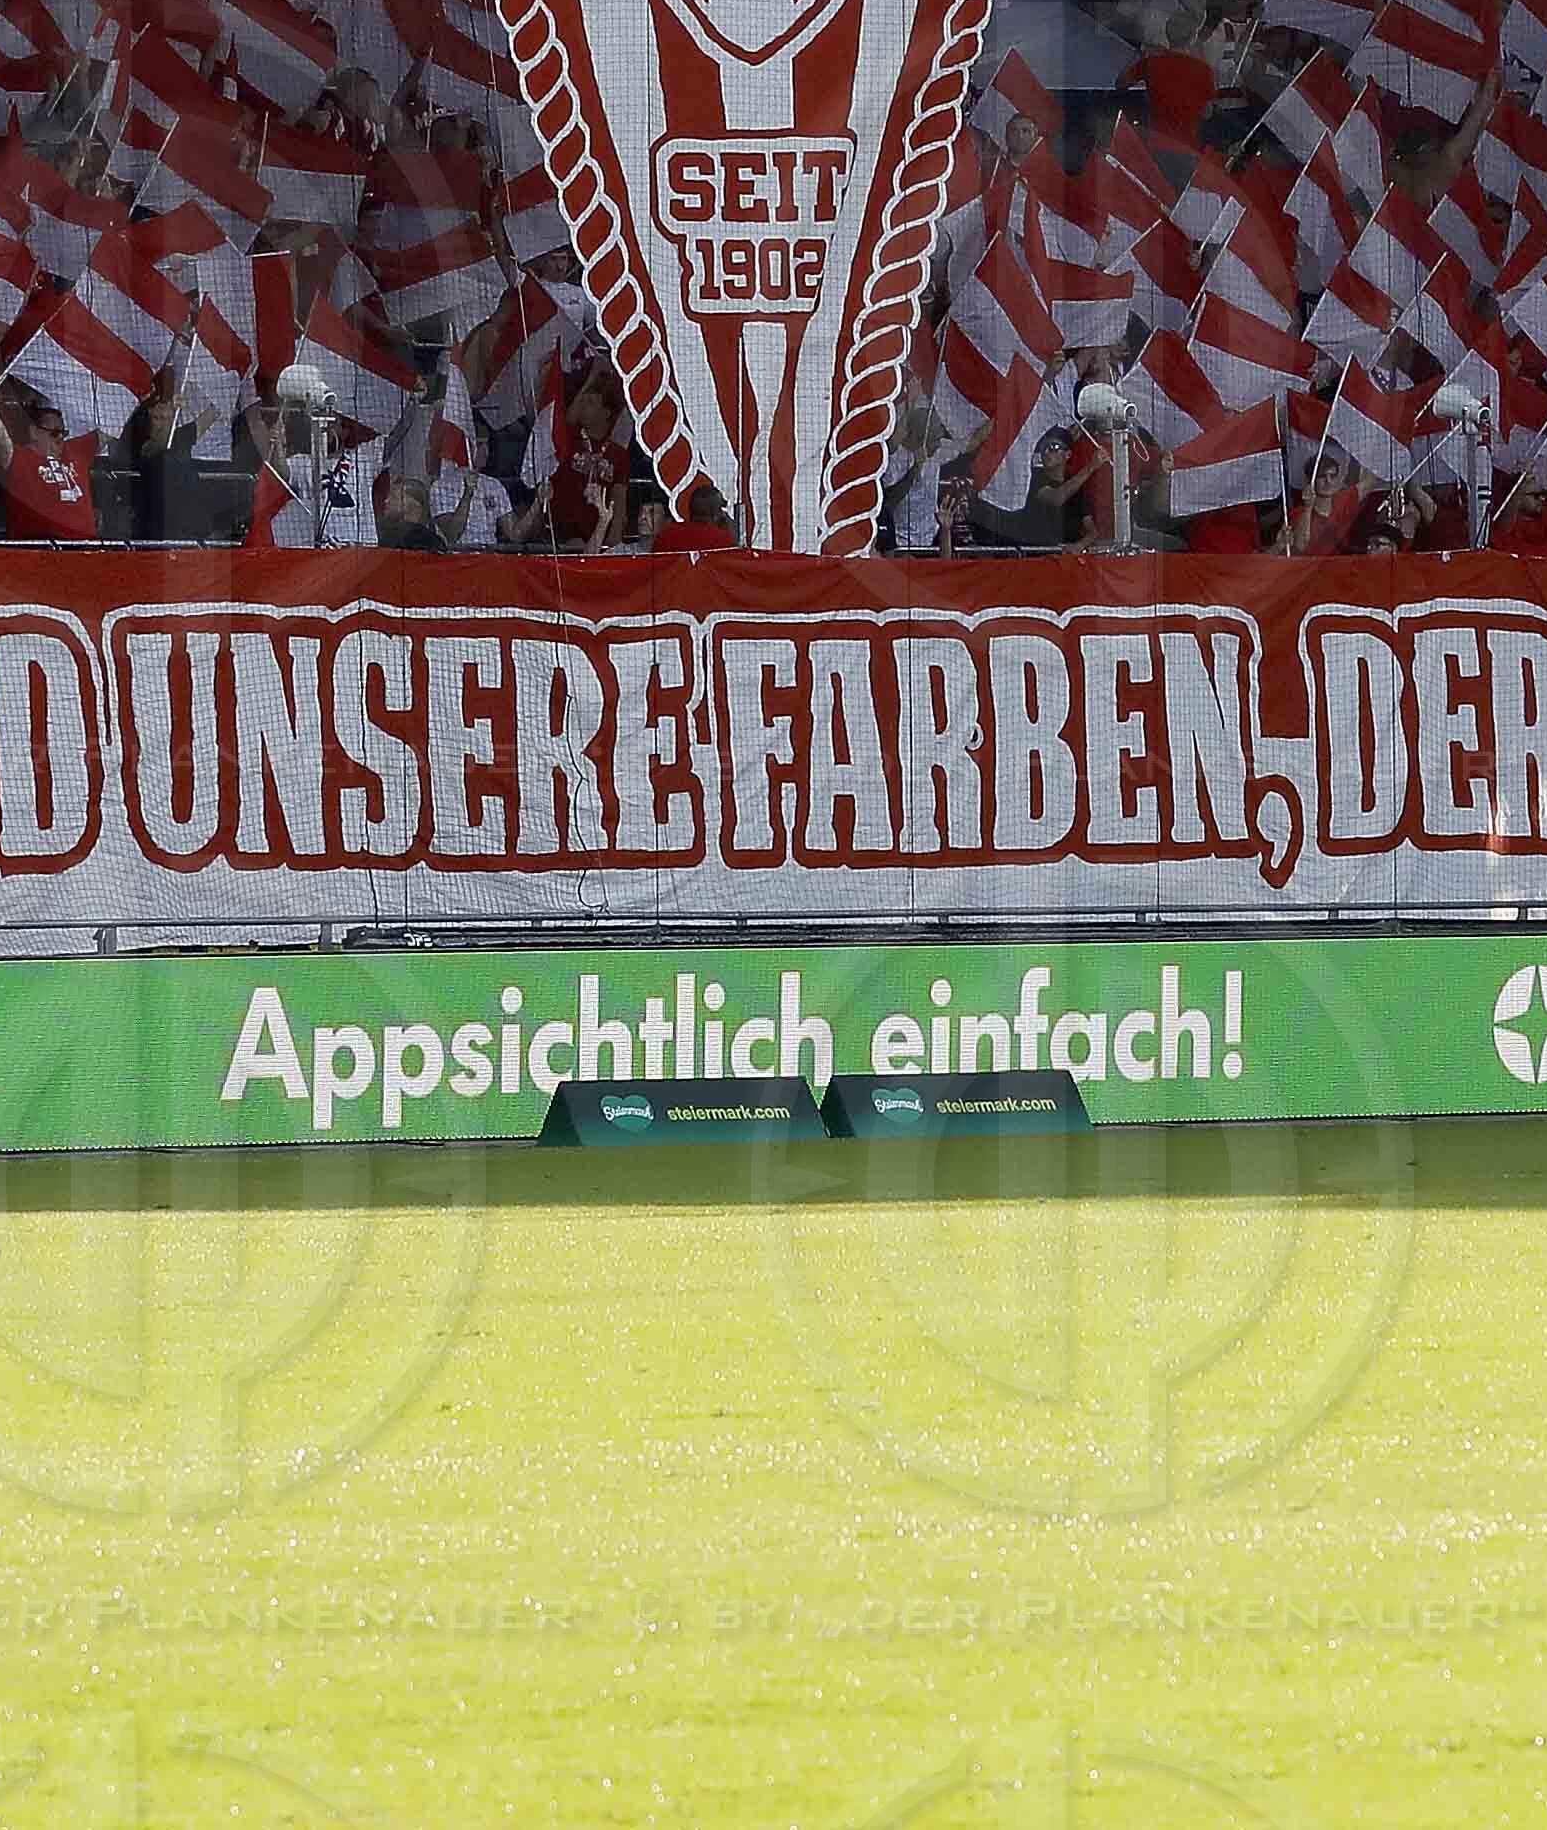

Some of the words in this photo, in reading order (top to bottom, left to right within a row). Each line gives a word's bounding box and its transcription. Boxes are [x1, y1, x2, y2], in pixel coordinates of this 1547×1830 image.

[667, 149, 851, 223] SEIT
[696, 237, 827, 302] 1902
[124, 626, 701, 861] UNSERE
[718, 626, 1303, 886] FARBEN,
[222, 973, 833, 1127] Appsichtlich
[870, 966, 1246, 1083] einfach!
[666, 1103, 792, 1123] steiermark.com
[935, 1095, 1057, 1116] steiermark.com
